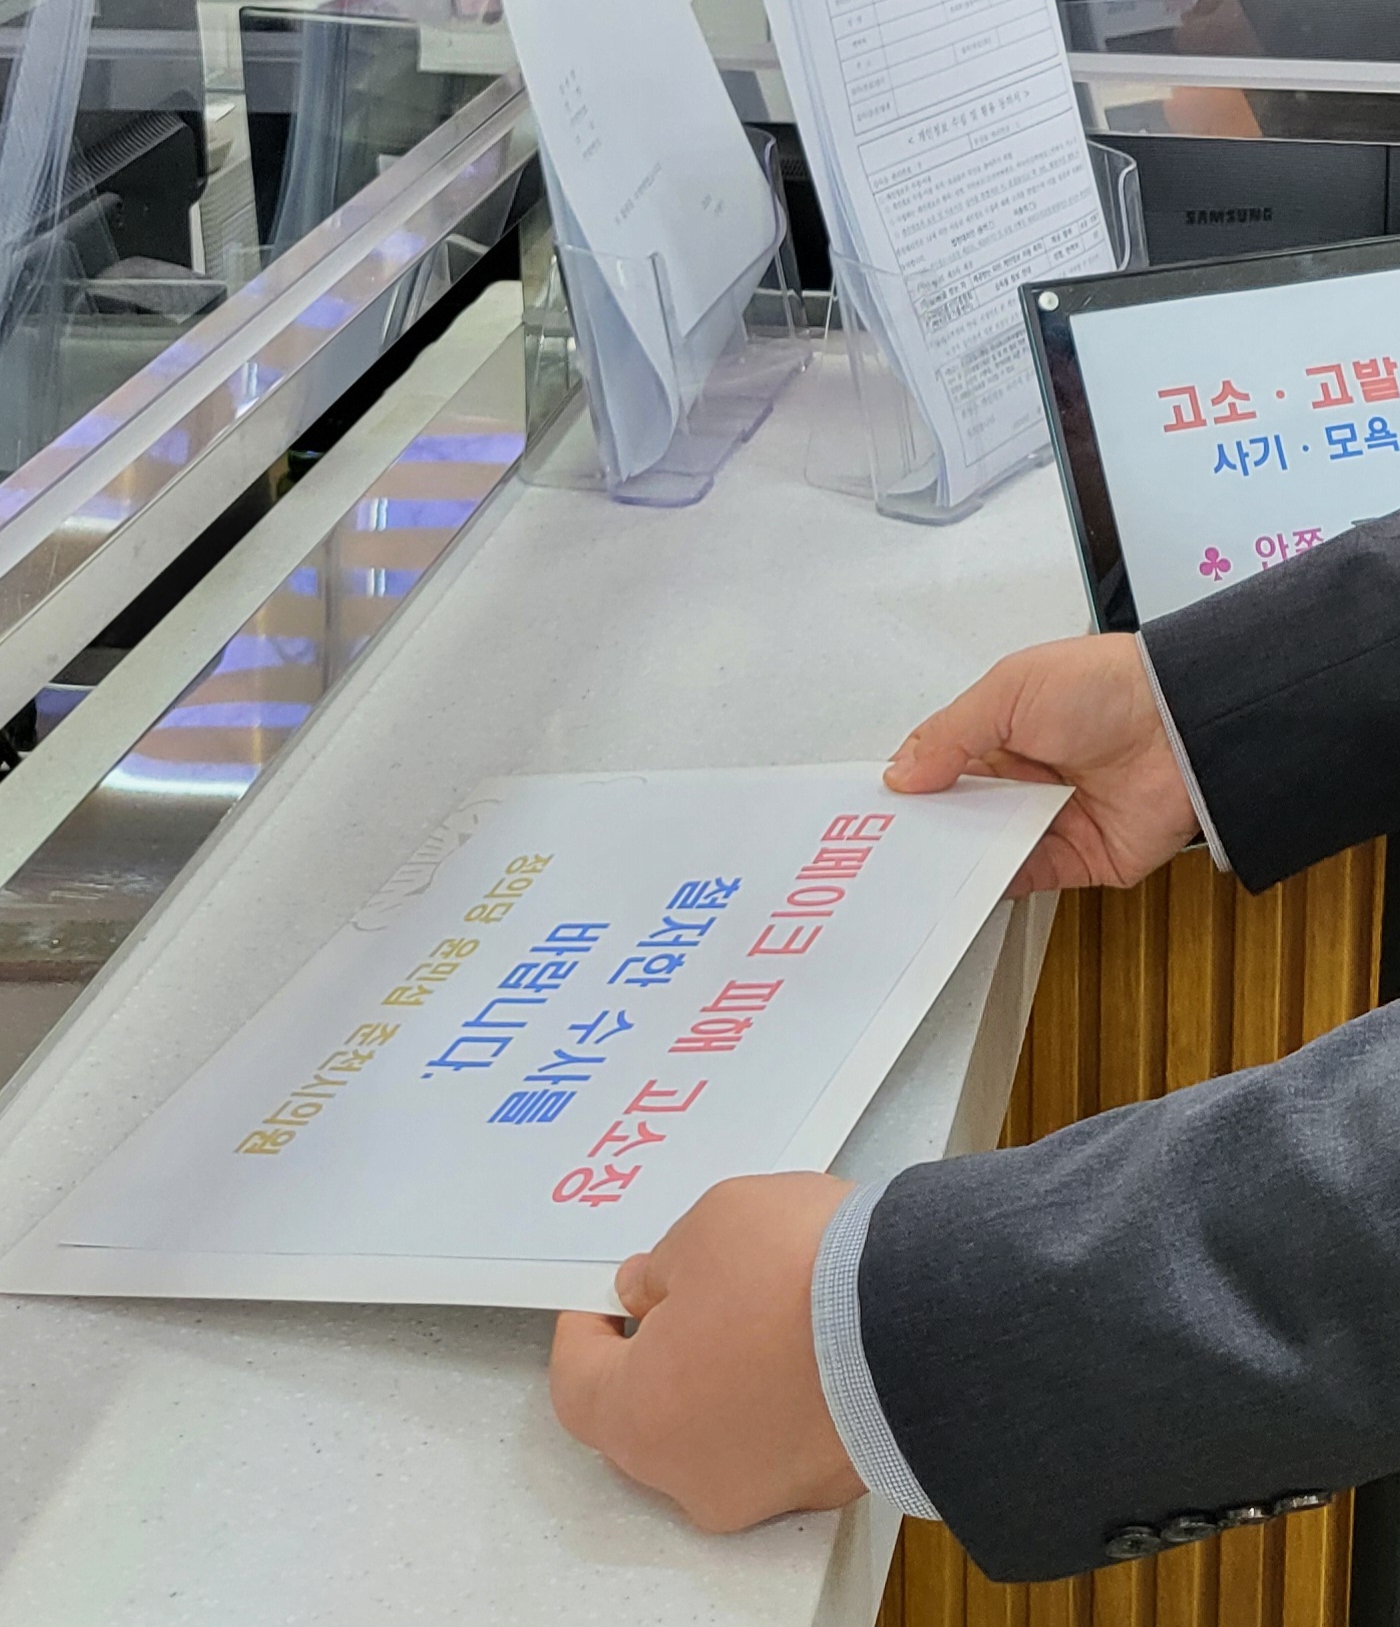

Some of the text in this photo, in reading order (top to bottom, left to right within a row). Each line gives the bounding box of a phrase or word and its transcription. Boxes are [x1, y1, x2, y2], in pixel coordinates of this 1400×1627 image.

[1185, 207, 1273, 225] SAMSUNG
[1157, 380, 1257, 434] 고소
[1305, 357, 1400, 410] 고발
[1213, 434, 1289, 478] 사기
[1325, 416, 1400, 462] 모욕
[233, 853, 554, 1155] 정의당 윤민섭 춘천시의원
[420, 921, 611, 1080] 바랍니다.
[486, 875, 743, 1126] 철저한 수사를
[551, 810, 896, 1208] 딥페이크 피해 고소장
